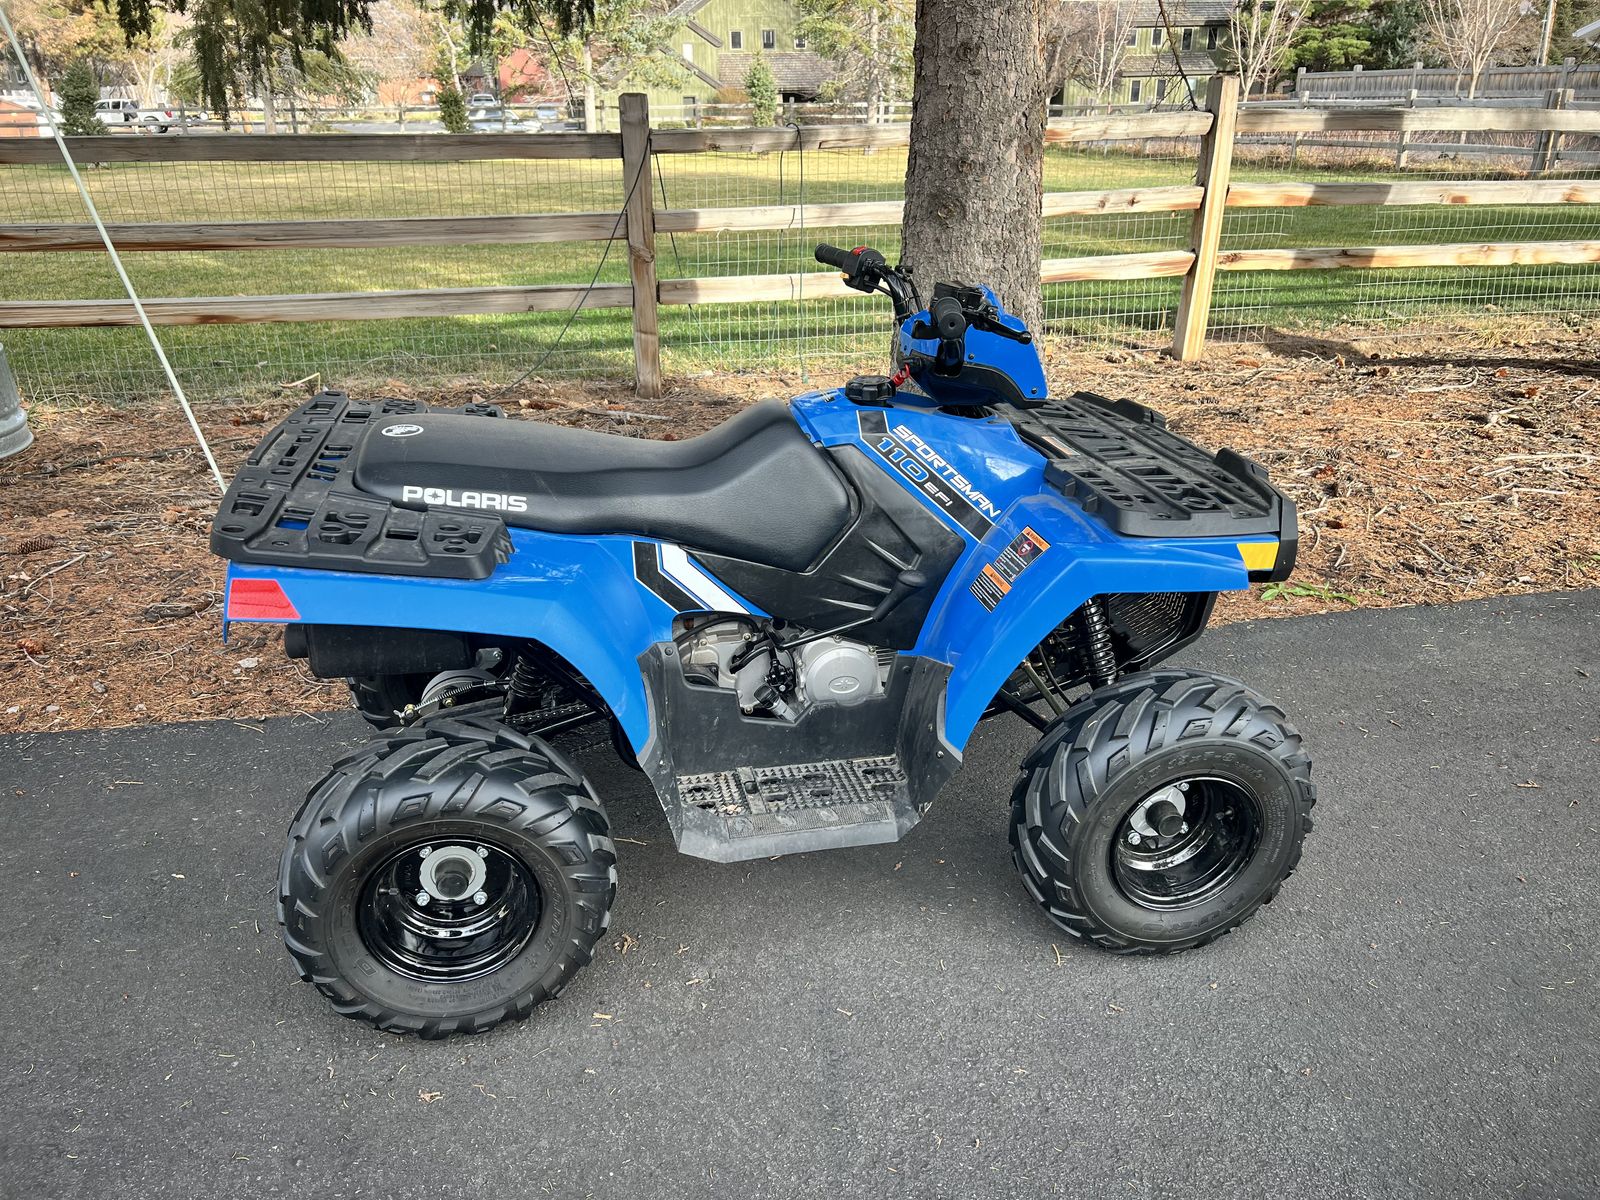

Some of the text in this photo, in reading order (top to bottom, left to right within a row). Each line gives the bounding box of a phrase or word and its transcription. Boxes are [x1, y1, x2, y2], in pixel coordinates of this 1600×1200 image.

[402, 485, 528, 512] POLARIS
[876, 436, 953, 507] 110 EFI
[892, 424, 1002, 518] SPORTSMAN
